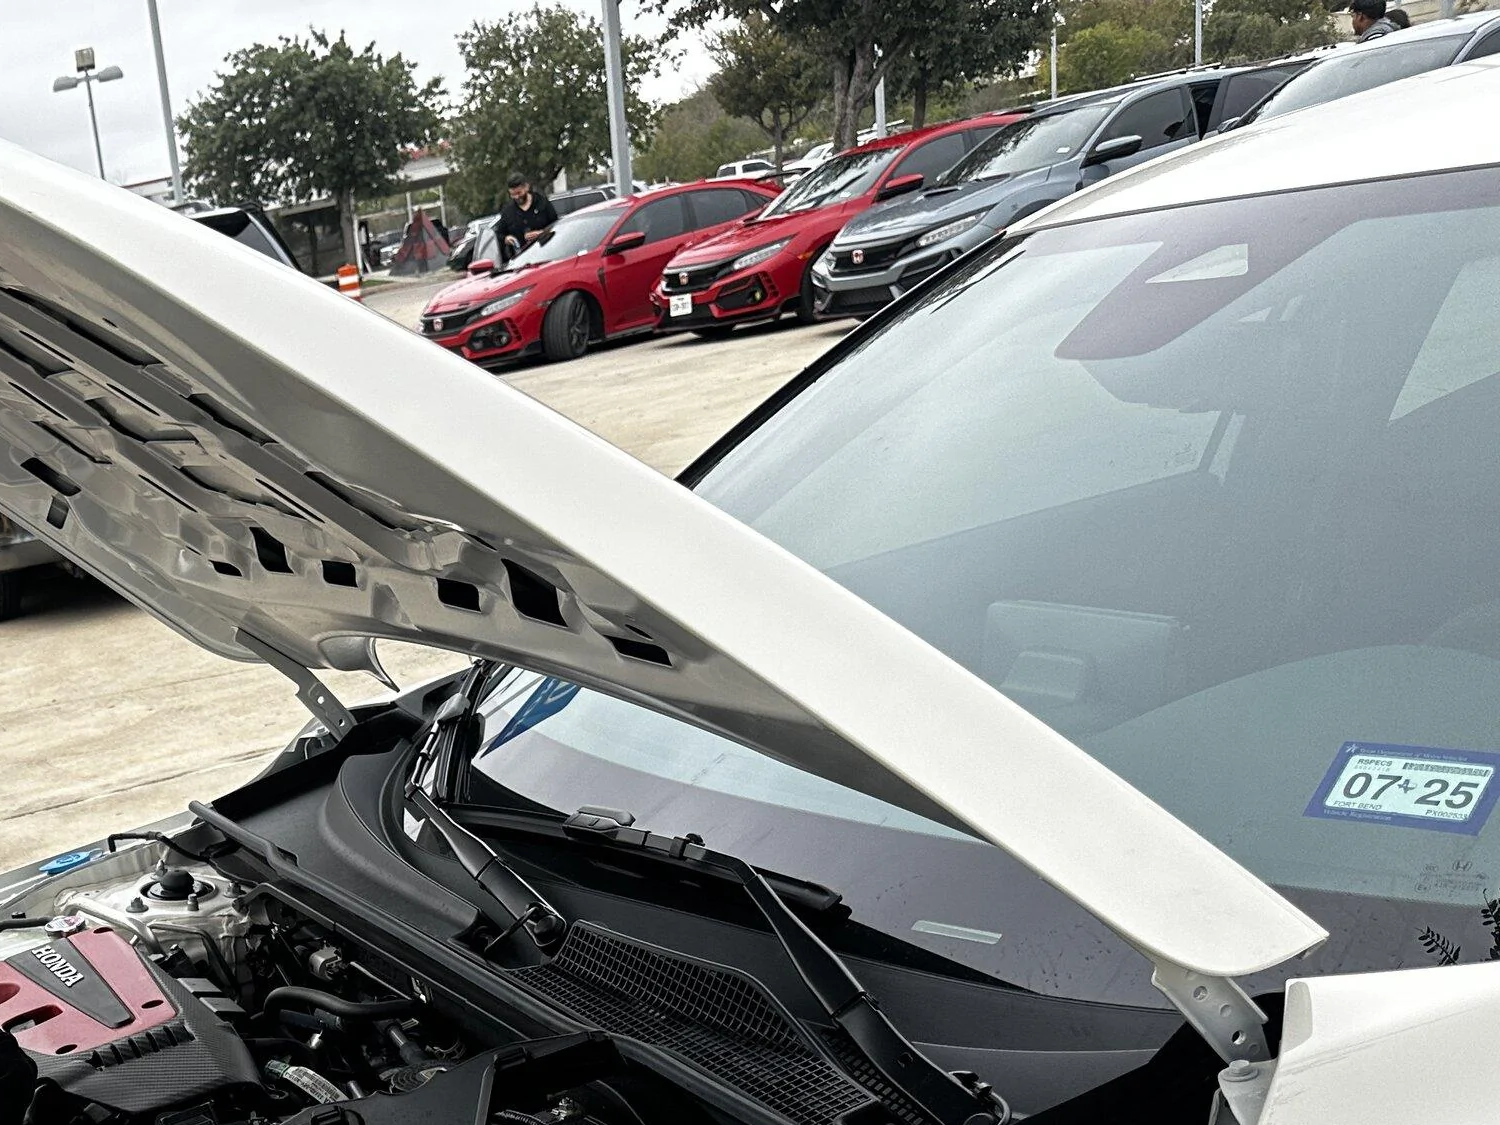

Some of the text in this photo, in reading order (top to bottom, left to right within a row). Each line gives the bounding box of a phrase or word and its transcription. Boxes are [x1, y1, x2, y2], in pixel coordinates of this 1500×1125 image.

[1332, 800, 1382, 811] FORT BEND
[1342, 772, 1480, 810] 07 25
[31, 944, 85, 988] HONDA
